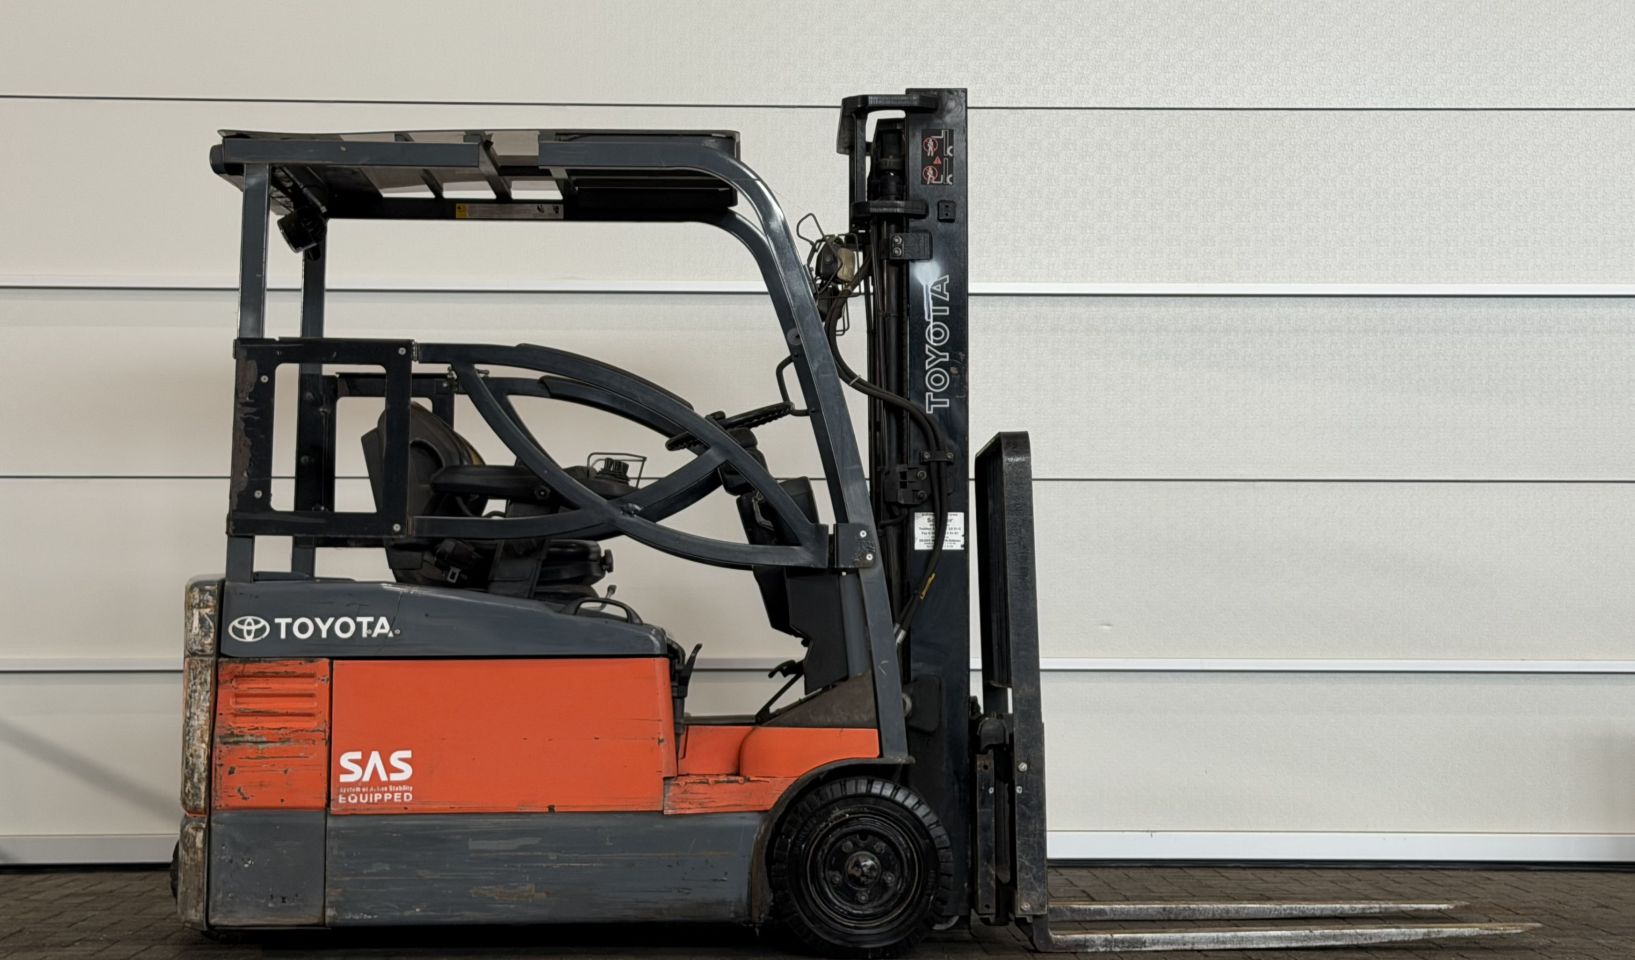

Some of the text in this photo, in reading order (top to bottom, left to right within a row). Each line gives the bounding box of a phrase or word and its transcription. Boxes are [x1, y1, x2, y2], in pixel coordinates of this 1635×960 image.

[925, 274, 950, 414] TOYOTA
[274, 616, 394, 640] TOYOTA
[339, 750, 413, 782] SAS
[338, 793, 413, 804] EQUIPPED
